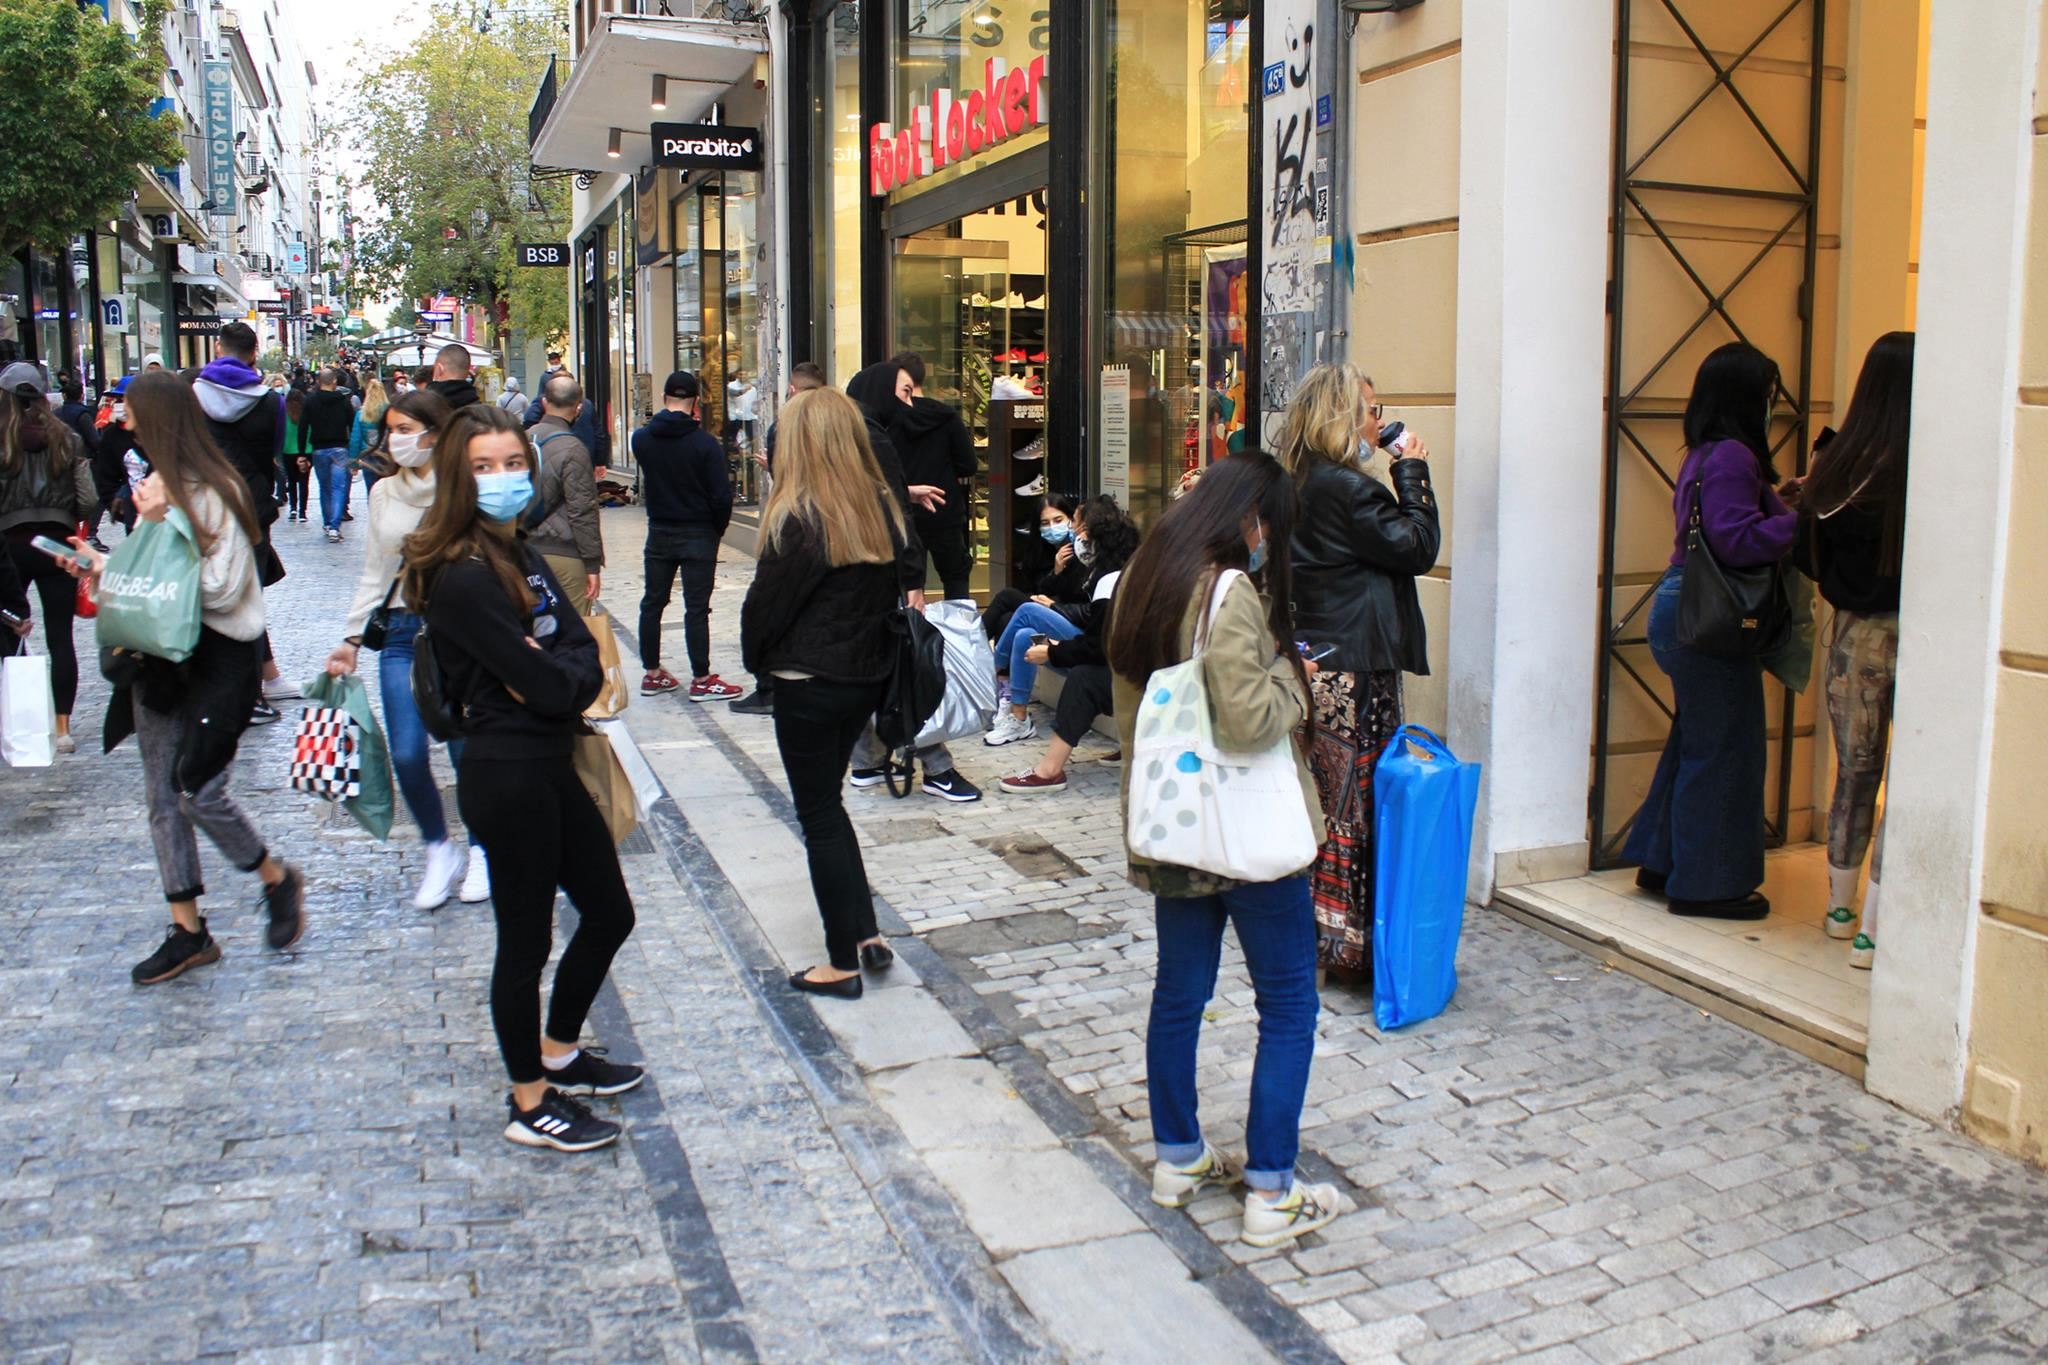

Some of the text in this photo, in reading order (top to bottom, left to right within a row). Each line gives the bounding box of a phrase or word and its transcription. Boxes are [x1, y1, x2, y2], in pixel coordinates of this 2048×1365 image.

[932, 54, 1049, 168] Locker
[663, 138, 742, 157] parabita
[526, 247, 559, 263] BSB
[179, 321, 220, 329] ROMANO
